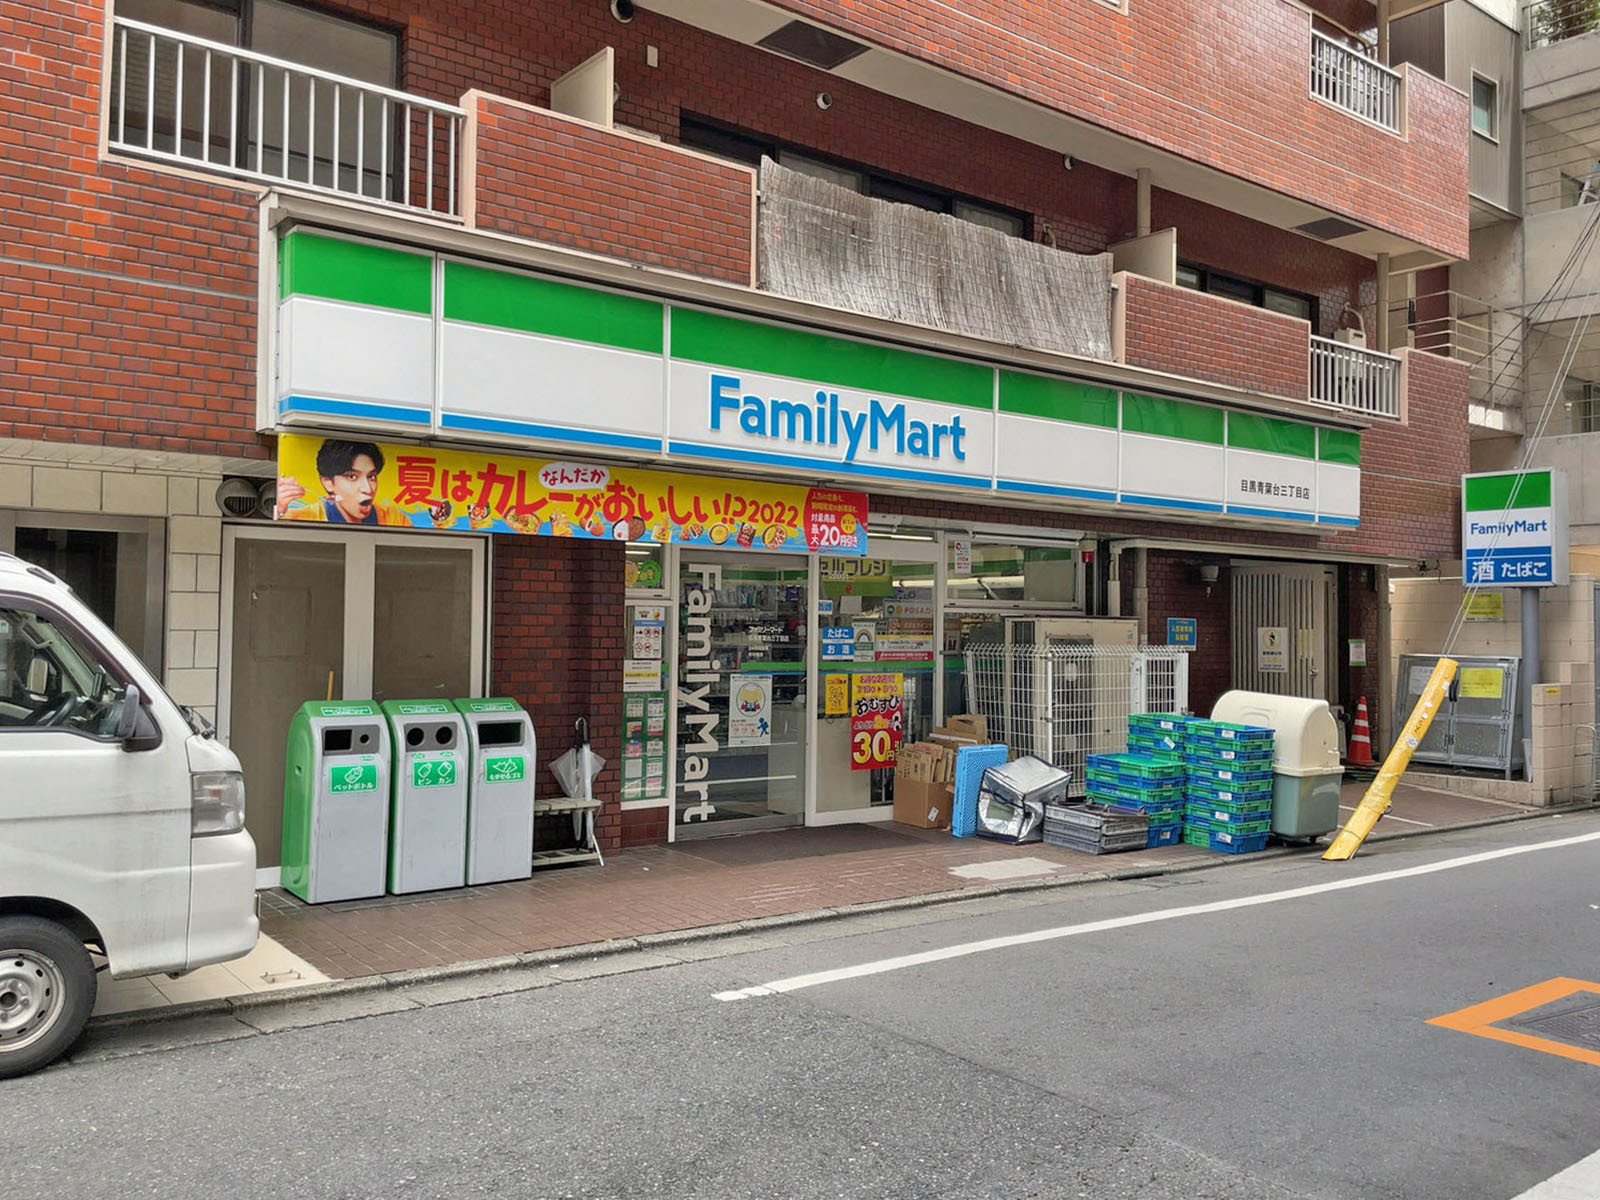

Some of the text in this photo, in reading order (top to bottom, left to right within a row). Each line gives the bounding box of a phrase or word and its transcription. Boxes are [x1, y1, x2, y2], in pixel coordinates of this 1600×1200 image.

[709, 373, 966, 464] FamilyMart
[541, 467, 607, 487] なんだか
[1240, 479, 1310, 500] 目黒青葉台三丁目店
[1469, 519, 1547, 536] FamilyMart
[1472, 561, 1547, 581] 酒 たばこ
[827, 628, 849, 638] たばこ
[678, 563, 722, 823] FamilyMart
[333, 782, 374, 791] ペットボトル
